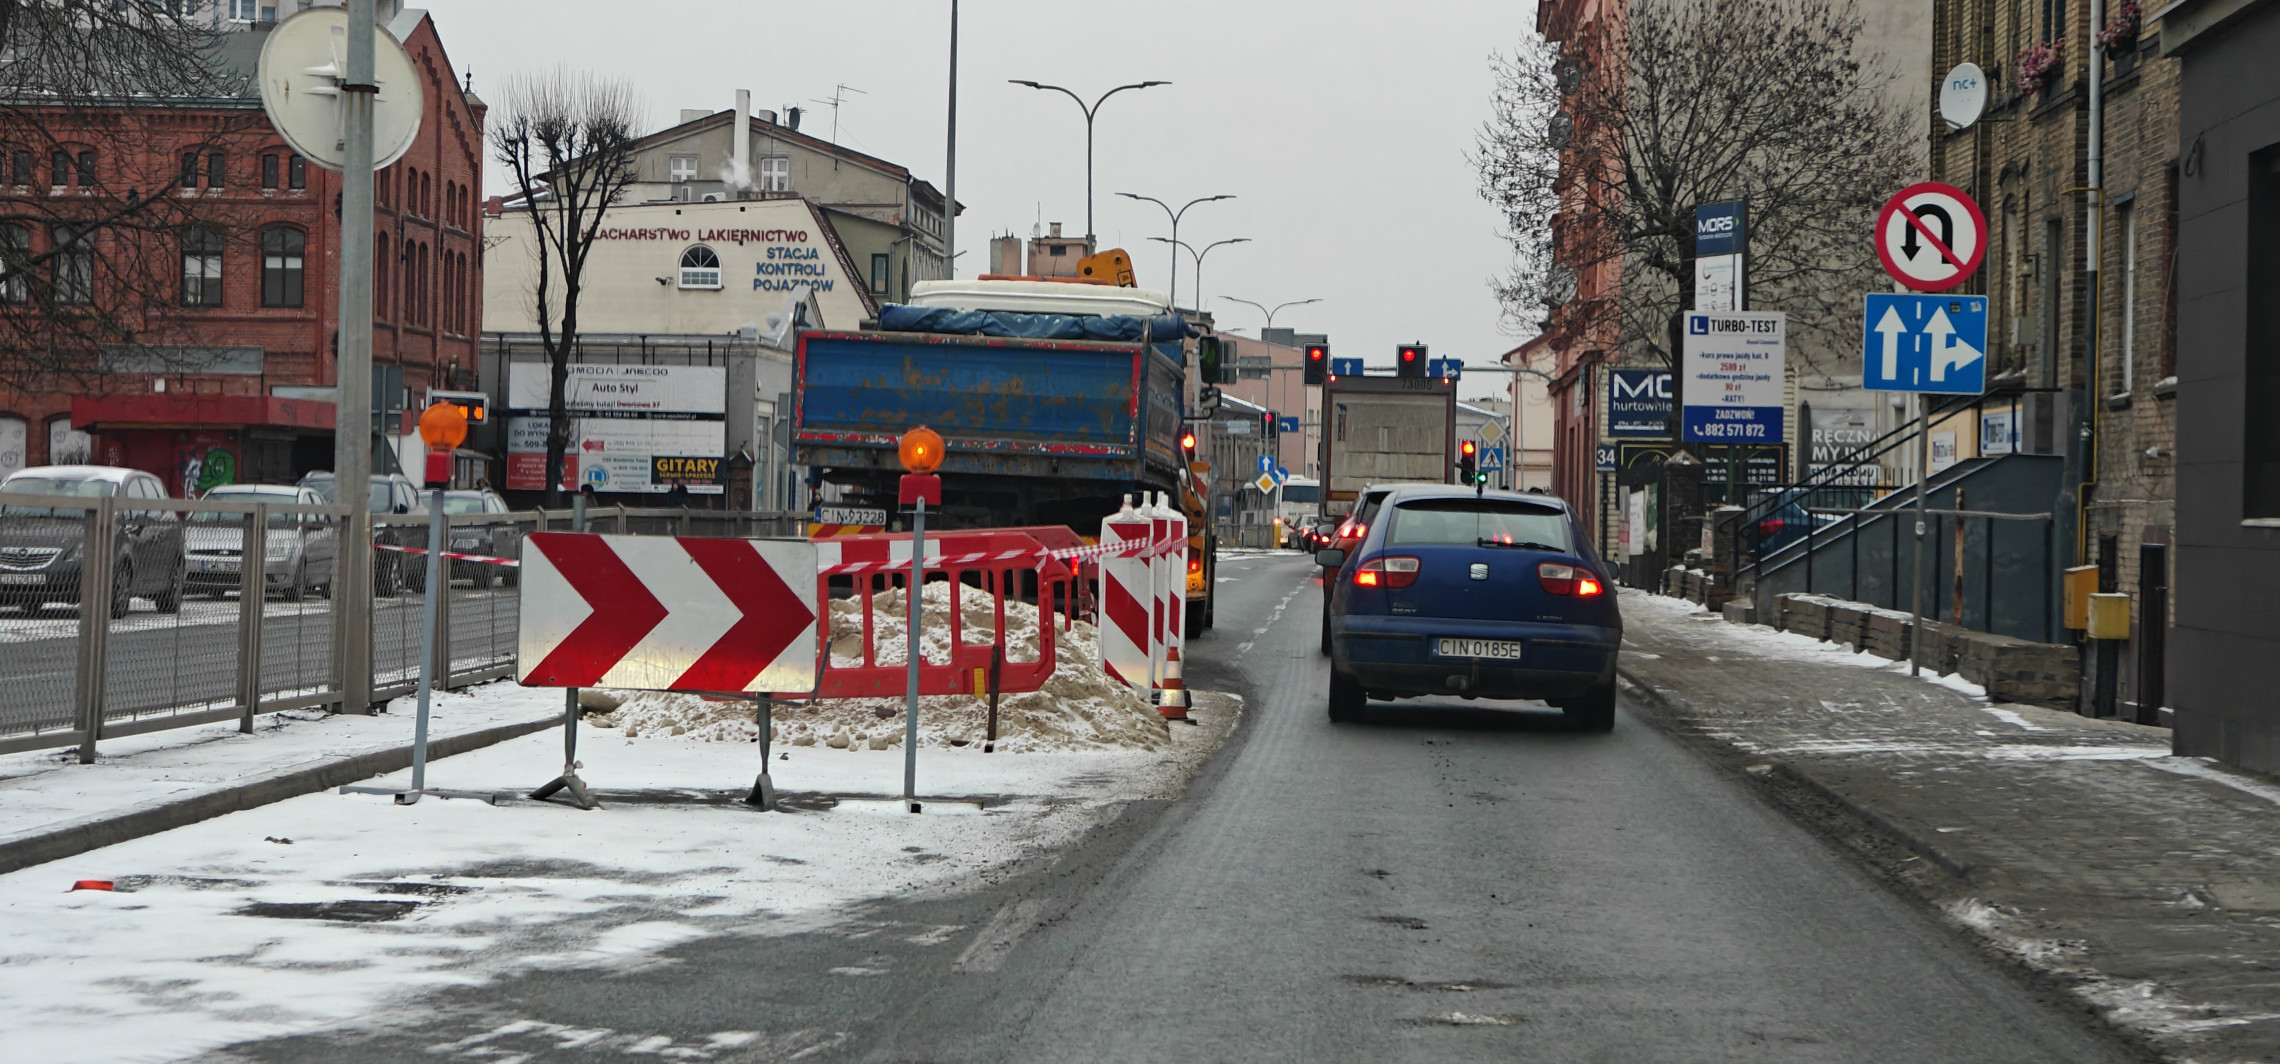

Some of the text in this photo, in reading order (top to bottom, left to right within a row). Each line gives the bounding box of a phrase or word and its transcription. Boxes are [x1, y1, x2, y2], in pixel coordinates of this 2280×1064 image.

[1953, 78, 1977, 91] nc+
[1698, 216, 1733, 233] MORS
[698, 229, 808, 242] LAKIERNICTWO
[767, 247, 819, 260] STACJA
[756, 262, 825, 276] KONTROLI
[1711, 319, 1777, 333] TURBO-TEST
[592, 383, 639, 395] Auto Styl
[1613, 400, 1673, 412] hurtownie
[1715, 408, 1755, 420] ZADZWOŃ!
[513, 429, 525, 437] DO
[1705, 423, 1765, 437] 882 571 872
[1597, 449, 1616, 465] 34
[656, 458, 719, 473] GITARY
[822, 509, 885, 524] CIN 93228
[1440, 640, 1519, 658] CIN 0185E
